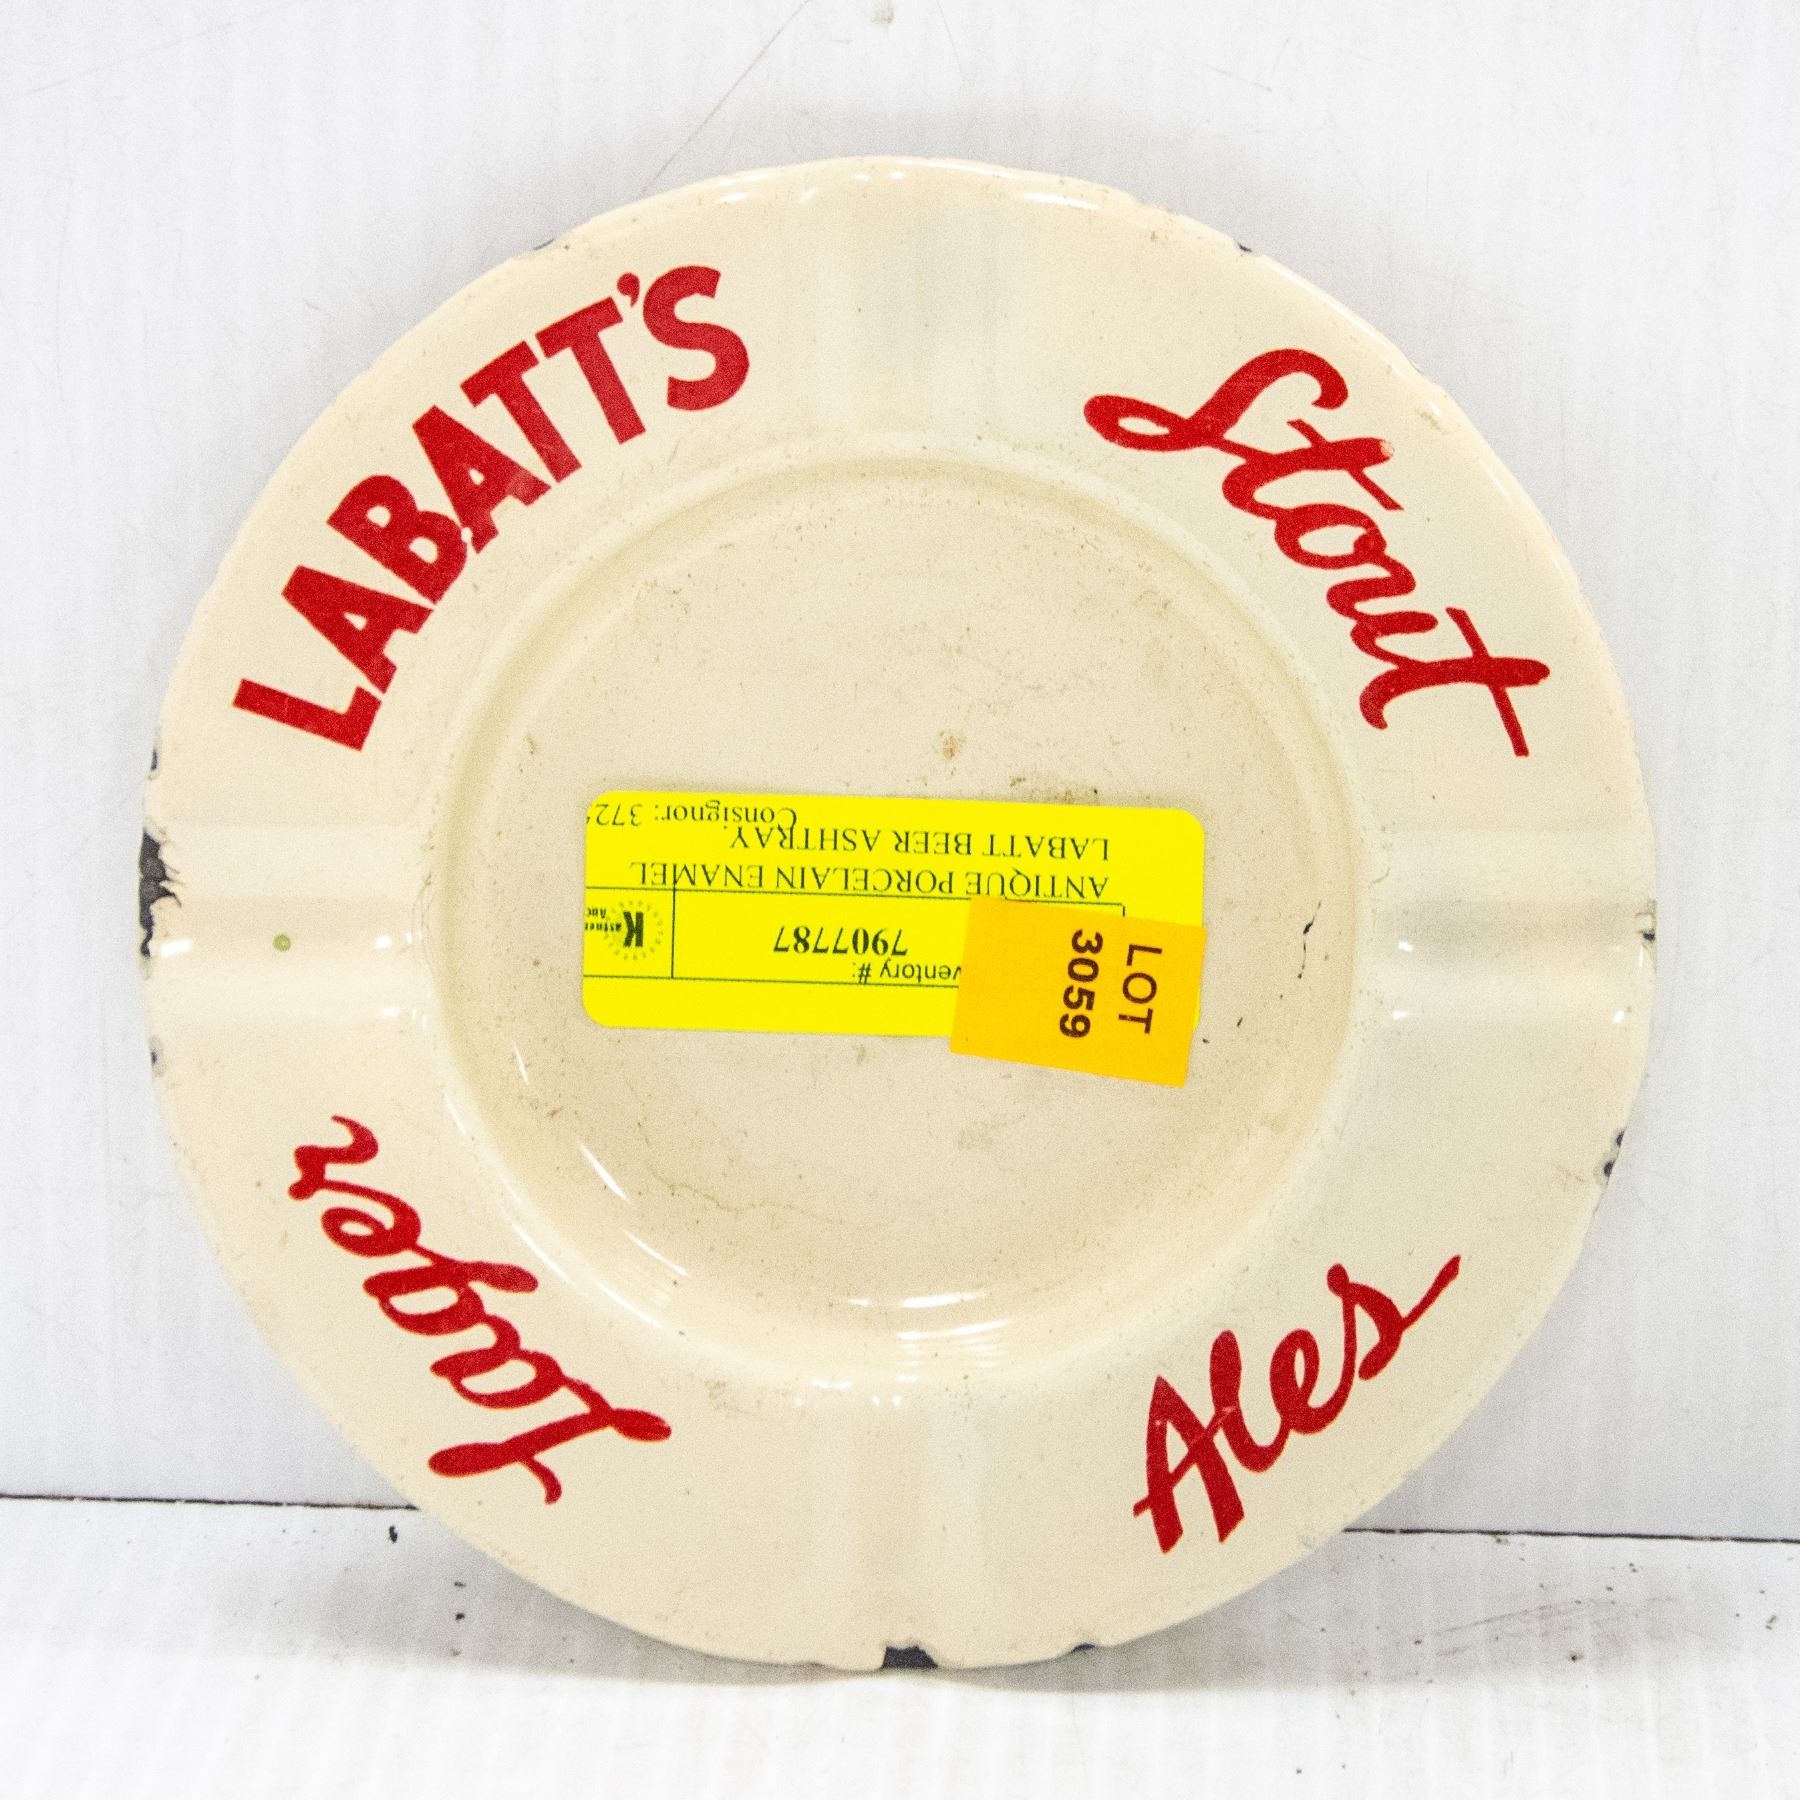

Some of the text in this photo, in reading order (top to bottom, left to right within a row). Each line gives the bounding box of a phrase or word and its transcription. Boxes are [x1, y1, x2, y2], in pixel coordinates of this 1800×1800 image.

[233, 266, 750, 752] LABATT'S
[1084, 349, 1550, 757] Stout
[585, 799, 798, 829] Consignor: 372
[892, 830, 973, 856] BEER
[629, 861, 1110, 899] ANTIQUE PORCELAIN ENAMEL
[982, 833, 1110, 862] LABATT
[772, 925, 908, 957] 7907787
[879, 957, 962, 981] ventory
[1058, 928, 1105, 1040] 3059
[1117, 943, 1164, 1035] LOT
[288, 1115, 672, 1504] Lager
[1133, 1255, 1461, 1553] Ales
